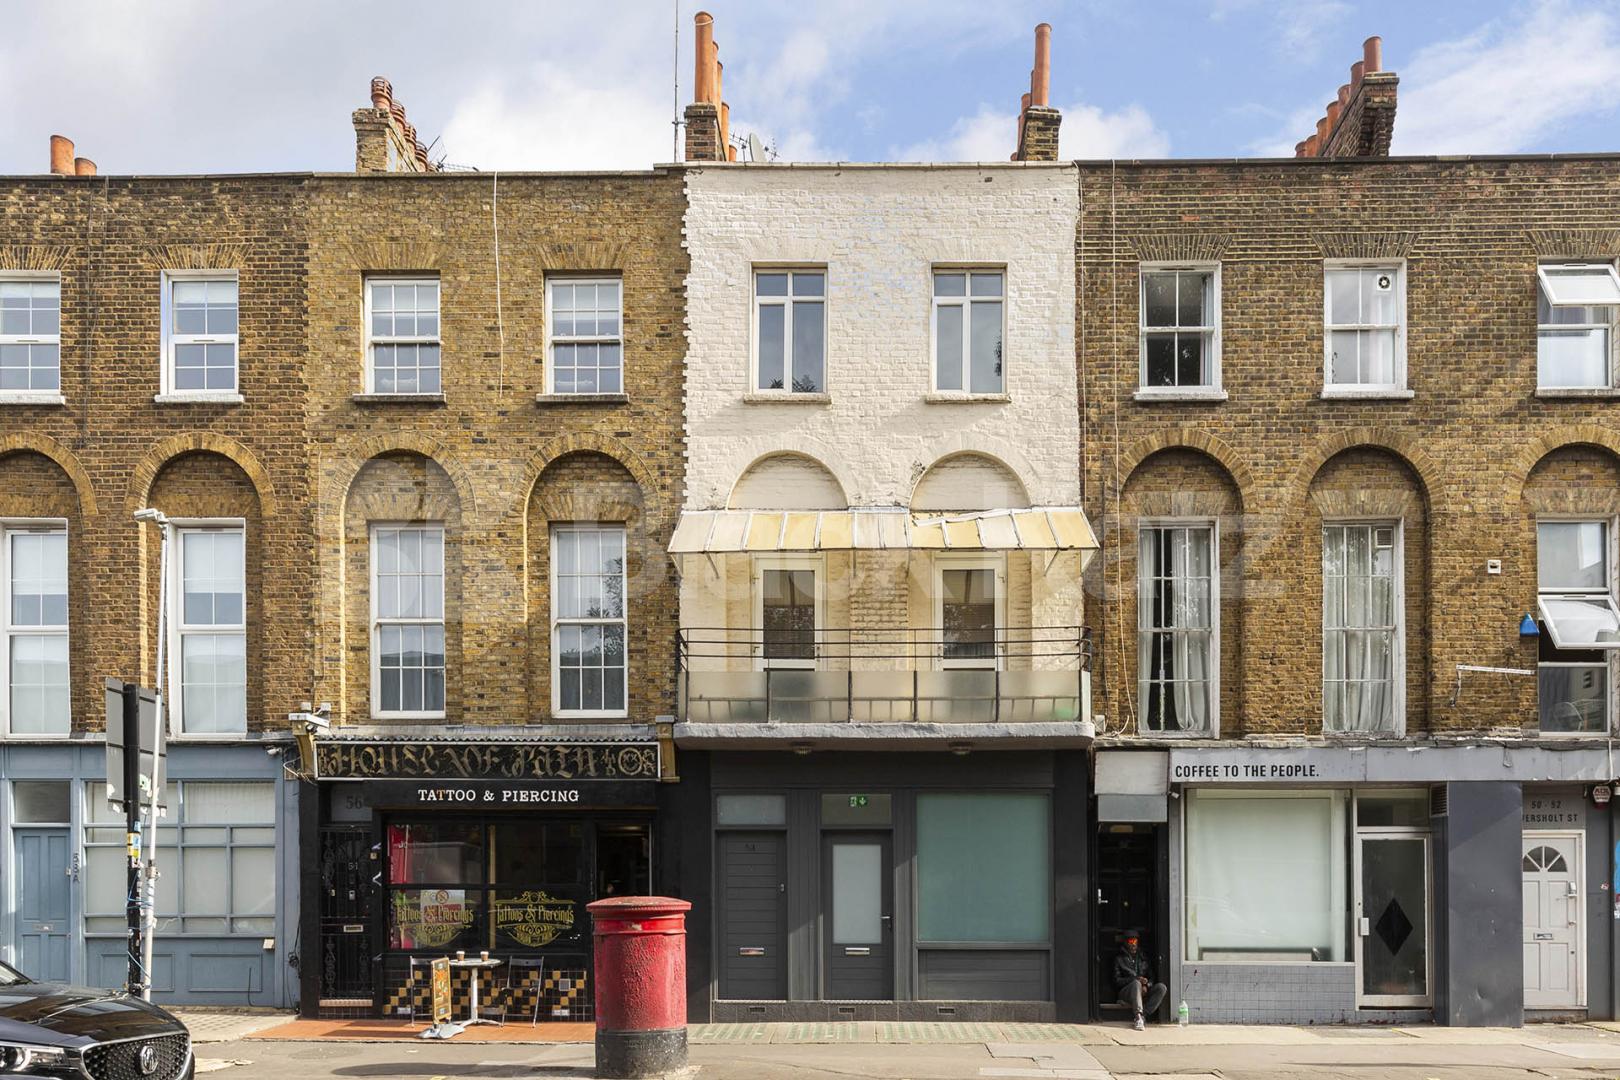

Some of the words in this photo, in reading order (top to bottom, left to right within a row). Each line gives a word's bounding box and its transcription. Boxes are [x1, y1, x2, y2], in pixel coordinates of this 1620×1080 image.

[1175, 765, 1219, 777] COFFEE
[1224, 765, 1239, 777] TO
[1244, 765, 1266, 777] THE
[1271, 765, 1320, 777] PEOPLE.
[418, 789, 476, 801] TATTOO
[483, 790, 495, 801] &
[502, 790, 579, 802] PIERCING
[1532, 800, 1542, 809] 50
[1551, 800, 1561, 809] 52
[1567, 814, 1578, 822] ST
[496, 903, 524, 924] Tattoos
[525, 904, 537, 924] &
[538, 904, 575, 923] Piercings
